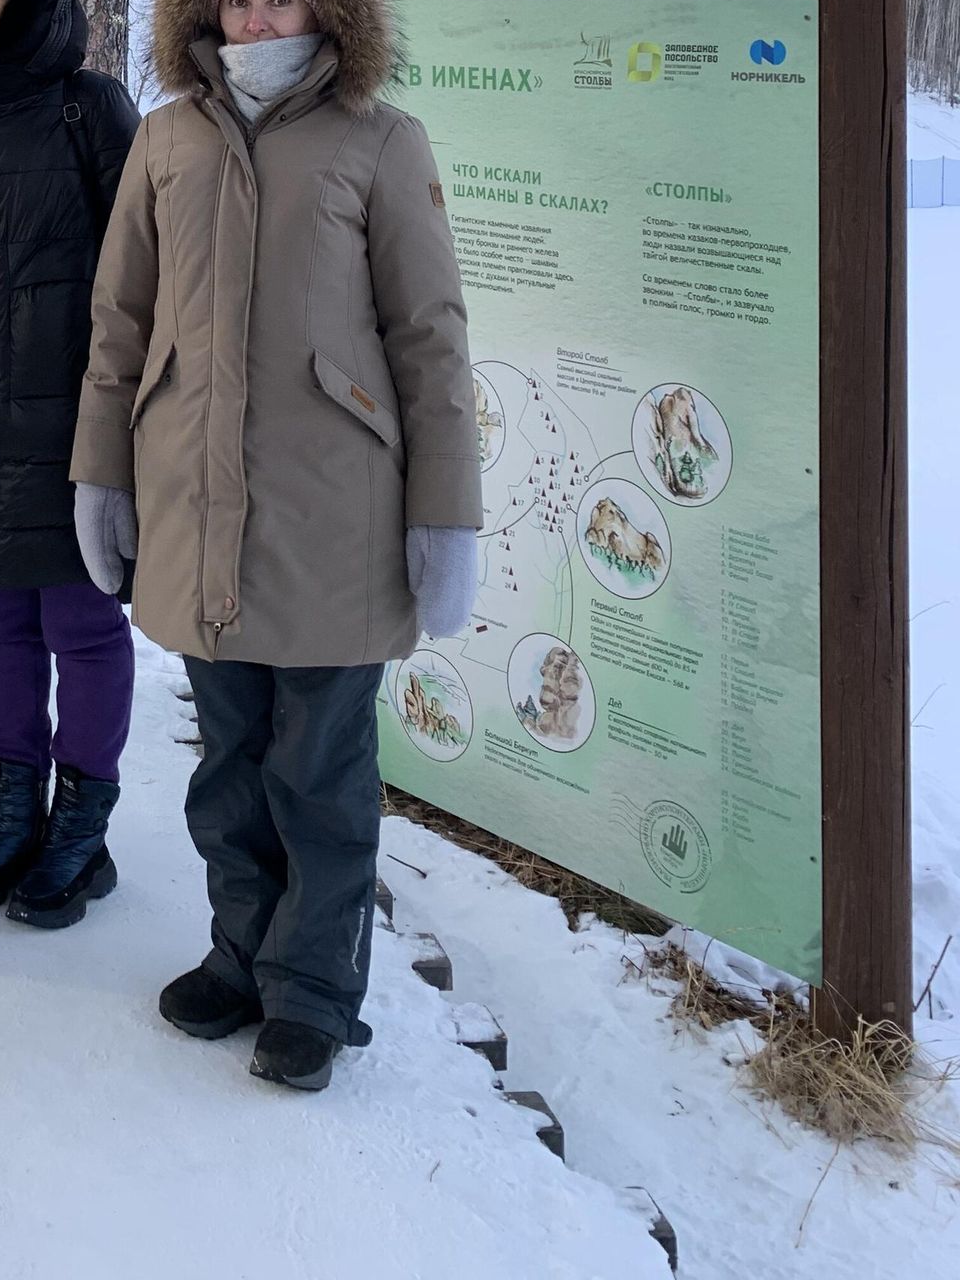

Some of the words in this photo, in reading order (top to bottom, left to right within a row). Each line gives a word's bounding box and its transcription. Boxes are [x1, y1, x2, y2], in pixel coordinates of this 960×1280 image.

[665, 44, 719, 53] ЗАПОВЕДНОЕ
[665, 54, 718, 63] ПОСОЛЬСТВО
[409, 64, 422, 87] В
[432, 65, 543, 92] ИМЕНАХ»
[574, 76, 612, 86] СТОЛБЫ
[731, 72, 806, 84] НОРНИКЕЛЬ
[453, 163, 479, 179] ЧТО
[484, 166, 541, 185] ИСКАЛИ
[453, 184, 518, 204] ШАМАНЫ
[525, 192, 534, 205] В
[540, 193, 609, 214] СКАЛАХ?
[645, 182, 732, 204] «СТОЛПЫ»
[488, 221, 519, 230] каменные
[688, 222, 700, 230] так
[703, 224, 752, 237] изначально,
[490, 232, 521, 241] внимание
[654, 230, 686, 241] времена
[688, 233, 792, 254] казаков-первопроходцев,
[463, 247, 479, 256] было
[480, 251, 503, 260] особое
[507, 244, 533, 254] раннего
[534, 248, 559, 258] железа
[642, 240, 662, 250] люди
[664, 244, 696, 253] назвали
[698, 247, 764, 263] возвышающиеся
[766, 256, 782, 266] над
[642, 250, 668, 262] тайгой
[670, 255, 734, 271] величественные
[737, 264, 764, 275] скалы.
[486, 272, 509, 281] духами
[517, 278, 556, 290] ритуальные
[508, 266, 553, 278] практиковали
[555, 273, 574, 282] здесь
[642, 274, 652, 282] Со
[654, 276, 692, 288] временем
[694, 282, 718, 292] слово
[720, 286, 742, 296] стало
[744, 288, 769, 300] более
[642, 286, 674, 298] звонким
[734, 300, 775, 314] зазвучало
[650, 298, 678, 310] полный
[680, 302, 704, 315] голос,
[706, 308, 736, 320] громко
[744, 314, 772, 325] гордо.
[556, 346, 584, 360] Второй
[585, 352, 608, 364] Столб
[590, 598, 617, 614] Первый
[619, 608, 644, 622] Столб
[608, 696, 622, 709] Дед
[484, 728, 513, 747] Большой
[514, 740, 539, 758] Беркут
